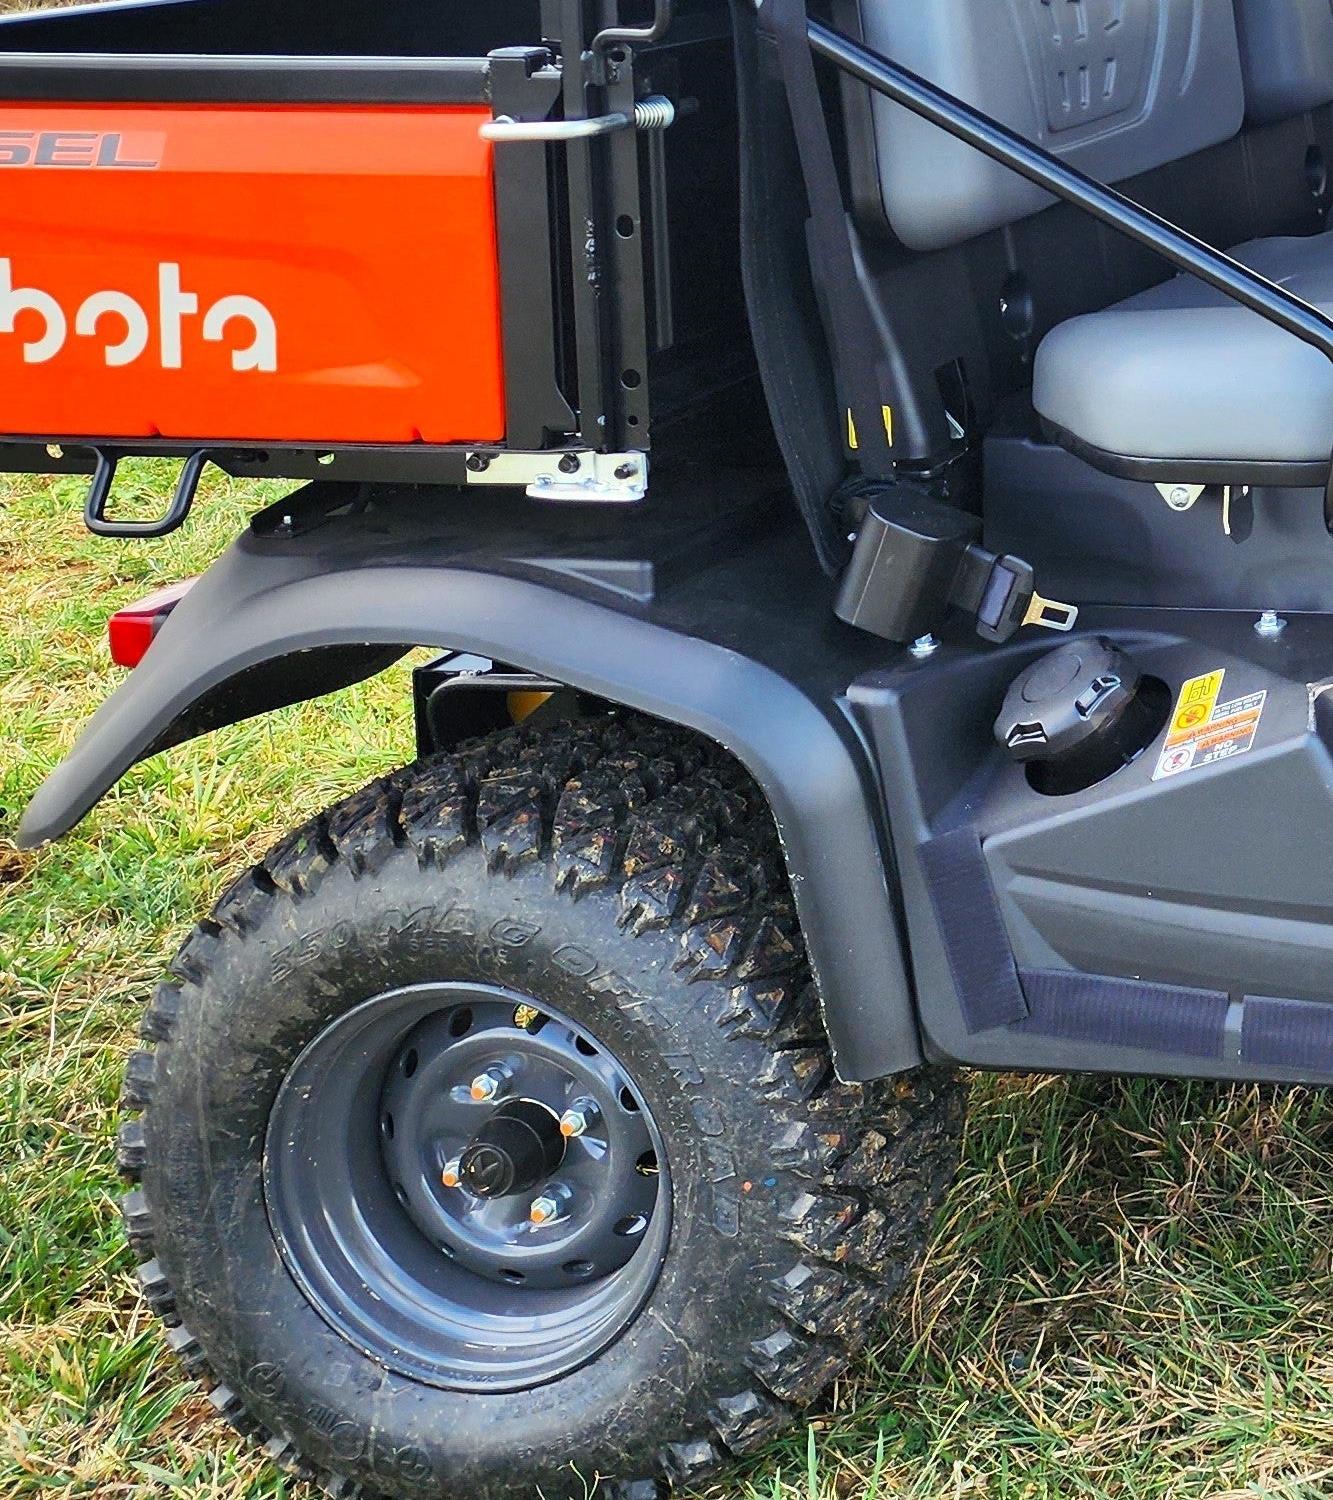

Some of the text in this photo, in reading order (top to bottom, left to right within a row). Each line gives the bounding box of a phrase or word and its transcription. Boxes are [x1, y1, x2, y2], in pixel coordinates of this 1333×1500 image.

[1197, 716, 1239, 736] WARNING
[1211, 725, 1252, 743] WARNING
[1203, 745, 1238, 762] STEP
[1213, 739, 1234, 752] NO
